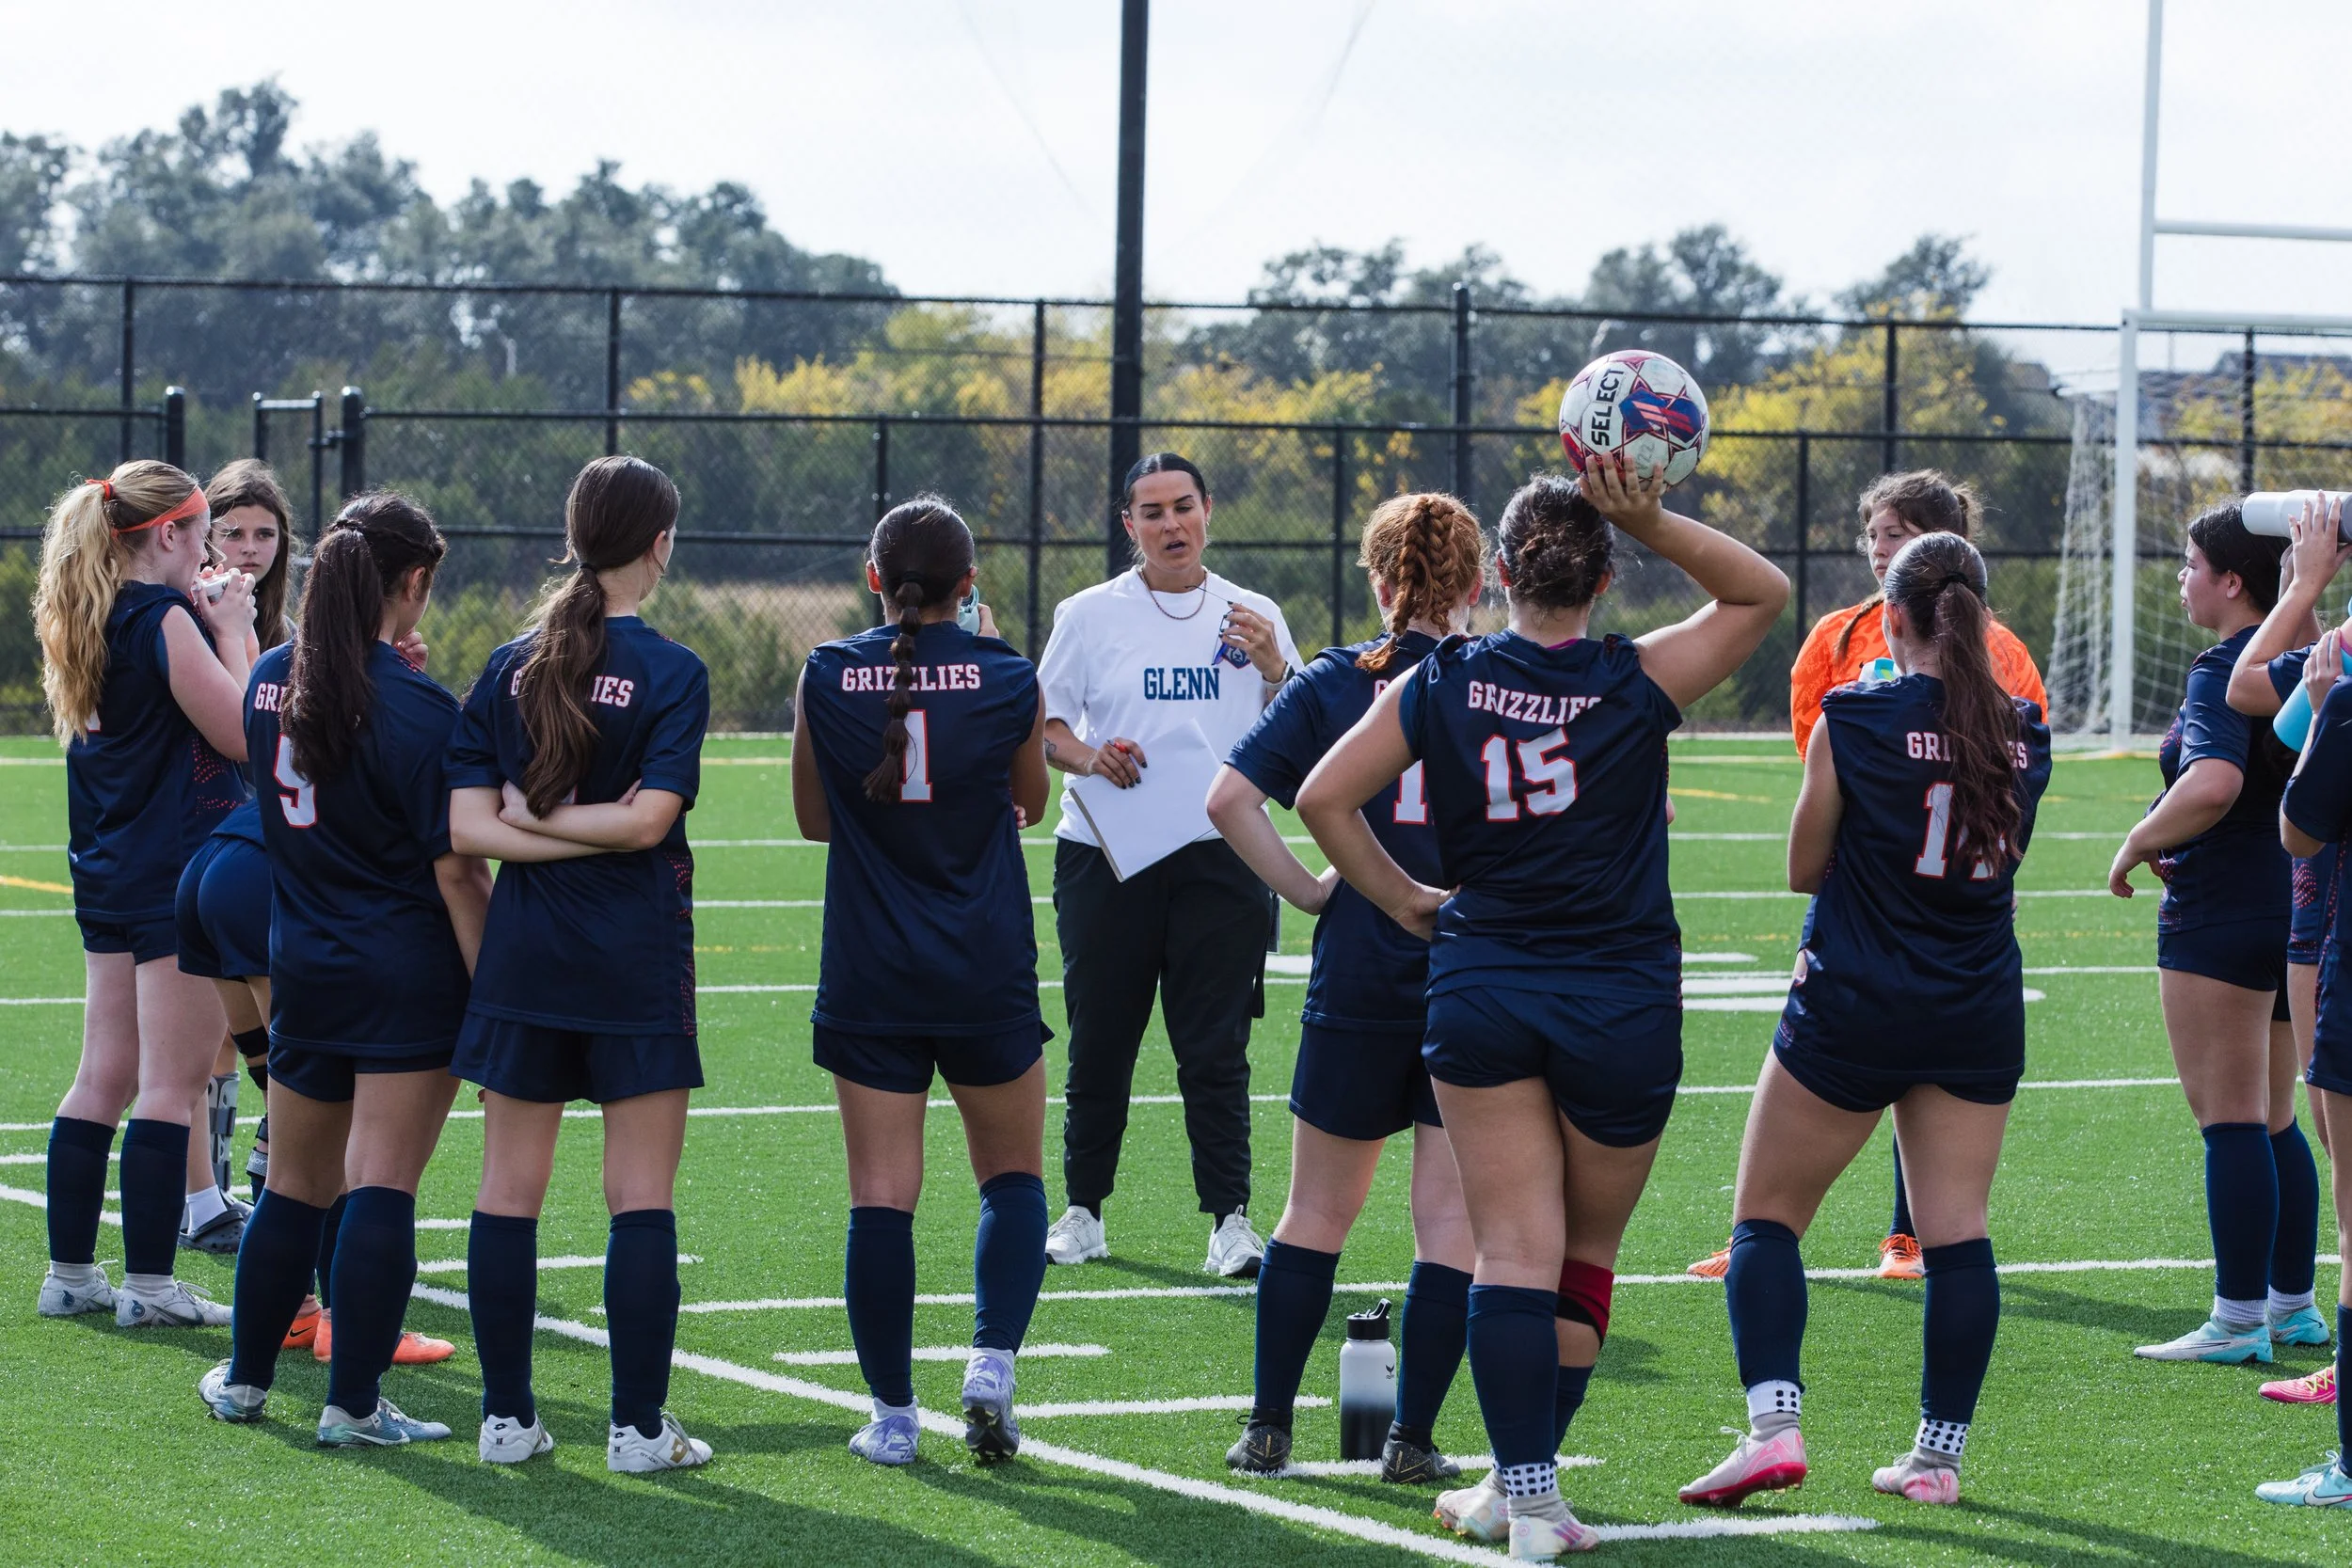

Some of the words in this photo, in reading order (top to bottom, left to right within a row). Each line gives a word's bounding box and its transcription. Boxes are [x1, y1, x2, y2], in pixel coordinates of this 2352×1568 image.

[1591, 368, 1624, 447] SELECT
[1144, 667, 1220, 700] GLENN
[900, 709, 933, 802] 1
[1480, 725, 1579, 822] 15
